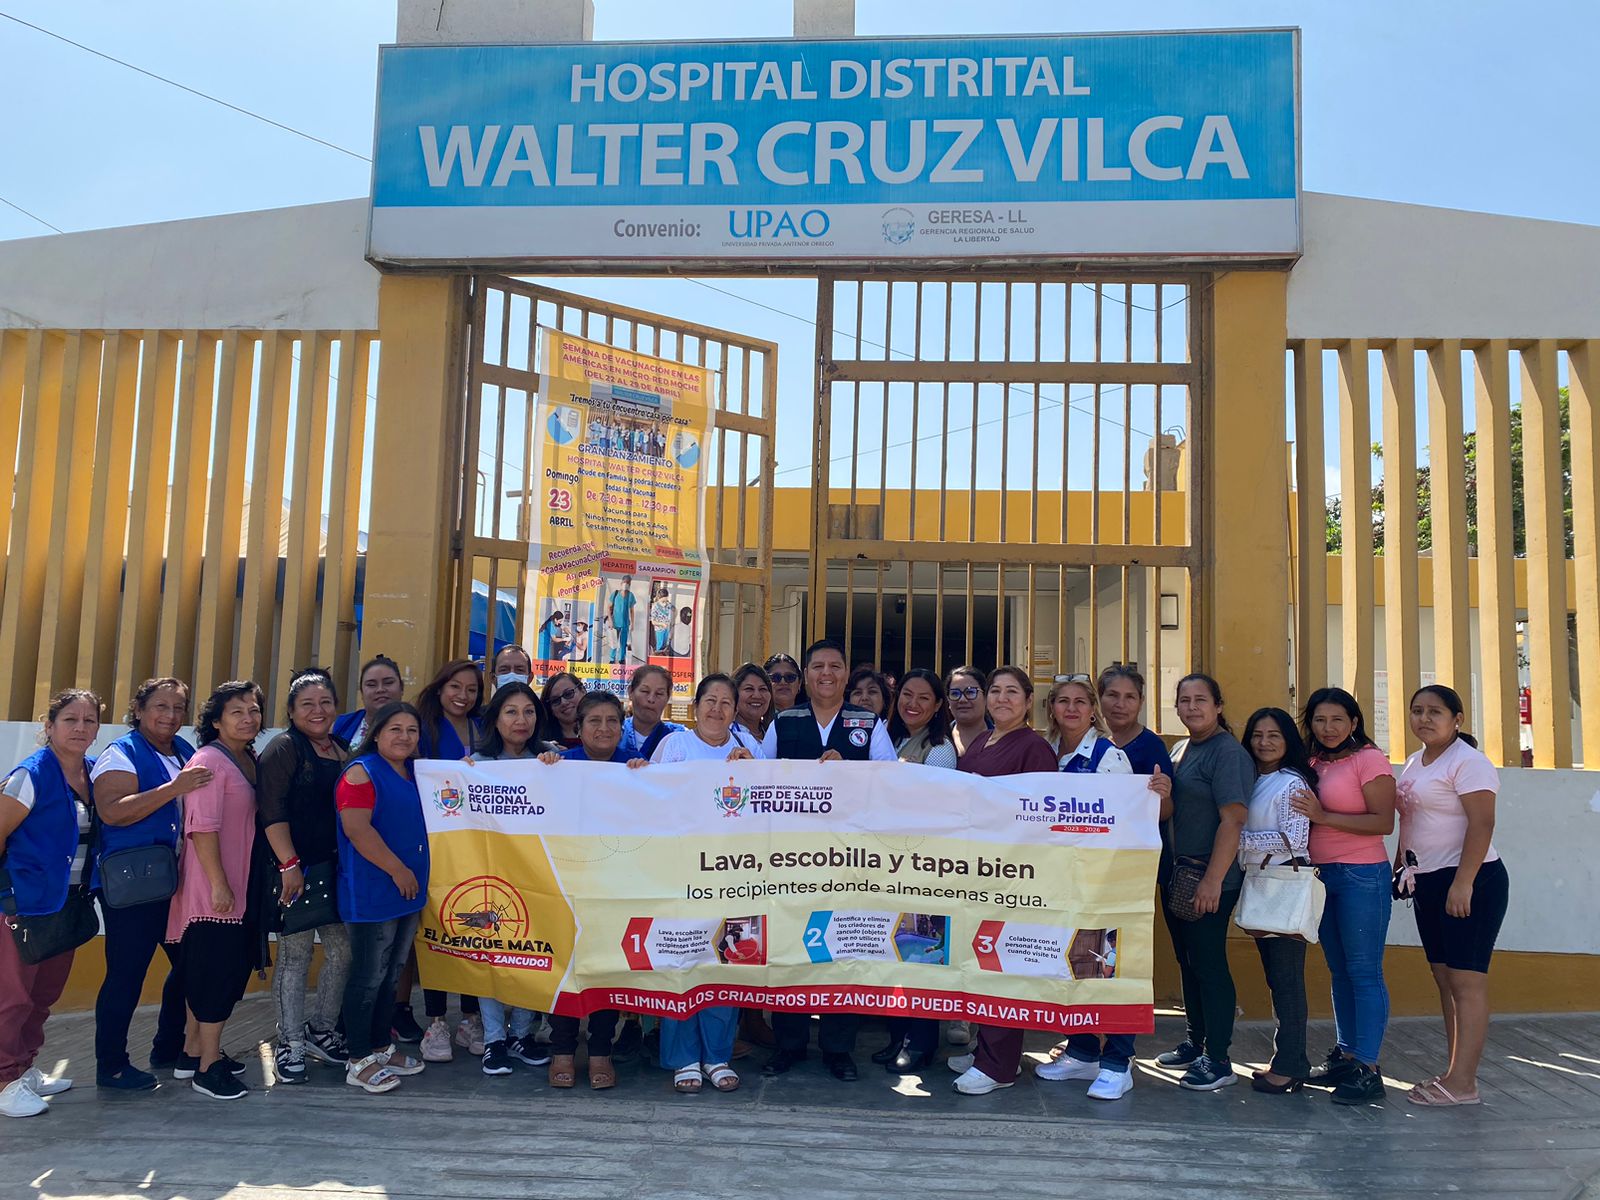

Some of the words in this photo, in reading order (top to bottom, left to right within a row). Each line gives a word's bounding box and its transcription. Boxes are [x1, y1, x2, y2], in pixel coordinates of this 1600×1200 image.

[570, 61, 817, 103] HOSPITAL
[829, 56, 1091, 99] DISTRITAL
[418, 123, 739, 187] WALTER
[756, 119, 984, 187] CRUZ
[996, 115, 1250, 183] VILCA
[729, 209, 830, 238] UPAO
[928, 210, 994, 224] GERESA
[1008, 209, 1027, 223] LL
[614, 218, 701, 238] Convenio:
[562, 342, 600, 359] SEMANA
[601, 352, 613, 361] DE
[671, 370, 682, 378] EN
[684, 372, 700, 382] LAS
[584, 369, 604, 381] (DEL
[605, 374, 615, 382] 22
[617, 377, 628, 386] AL
[640, 383, 652, 391] DE
[654, 386, 681, 398] ABRIL)
[609, 365, 622, 374] EN
[670, 380, 700, 393] MOCHE
[578, 443, 607, 457] GRAN
[607, 449, 672, 468] LANZAMIENTO
[546, 468, 579, 485] Domingo
[567, 455, 606, 469] HOSPITAL
[608, 462, 640, 474] WALTER
[641, 468, 662, 478] CRUZ
[662, 472, 685, 482] VILCA
[548, 488, 572, 511] 23
[586, 490, 597, 500] De
[603, 506, 632, 517] Vacunas
[633, 511, 648, 520] para
[550, 516, 574, 528] ABRIL
[615, 535, 634, 543] Covid
[548, 544, 581, 560] Recuerda
[582, 541, 595, 551] que
[578, 568, 592, 579] que
[602, 561, 634, 570] HEPATITIS
[569, 666, 609, 675] INFLUENZA
[467, 784, 527, 795] GOBIERNO
[750, 791, 773, 800] RED
[776, 791, 791, 800] DE
[794, 791, 833, 800] SALUD
[468, 793, 531, 805] REGIONAL
[750, 801, 832, 813] TRUJILLO
[1019, 798, 1039, 812] Tu
[1043, 795, 1105, 814] Salud
[470, 803, 483, 813] LA
[485, 805, 545, 815] LIBERTAD
[1015, 813, 1056, 823] nuestra
[1058, 813, 1115, 825] Prioridad
[700, 851, 763, 873] Lava,
[769, 847, 882, 869] escobilla
[888, 852, 905, 874] y
[911, 854, 969, 877] tapa
[977, 857, 1035, 879] bien
[686, 884, 713, 900] los
[719, 879, 817, 901] recipientes
[821, 879, 880, 894] donde
[886, 881, 989, 904] almacenas
[994, 892, 1048, 909] agua.
[807, 928, 822, 947] 2
[862, 928, 887, 936] (objetos
[1008, 935, 1037, 943] Colabora
[423, 927, 438, 942] EL
[441, 932, 504, 950] DENGUE
[508, 940, 554, 954] MATA
[630, 934, 640, 953] 1
[656, 941, 689, 949] recipientes
[977, 935, 993, 954] 3
[1005, 941, 1033, 950] personal
[1043, 945, 1061, 953] salud
[1007, 948, 1031, 956] cuando
[1032, 950, 1050, 958] visite
[494, 955, 549, 968] ZANCUDO!
[609, 993, 687, 1013] ¡ELIMINAR
[688, 990, 714, 1010] LOS
[717, 989, 807, 1007] CRIADEROS
[809, 993, 830, 1006] DE
[833, 993, 908, 1009] ZANCUDO
[911, 996, 963, 1013] PUEDE
[966, 1002, 1030, 1022] SALVAR
[1034, 1009, 1055, 1024] TU
[1059, 1011, 1100, 1027] VIDA!
